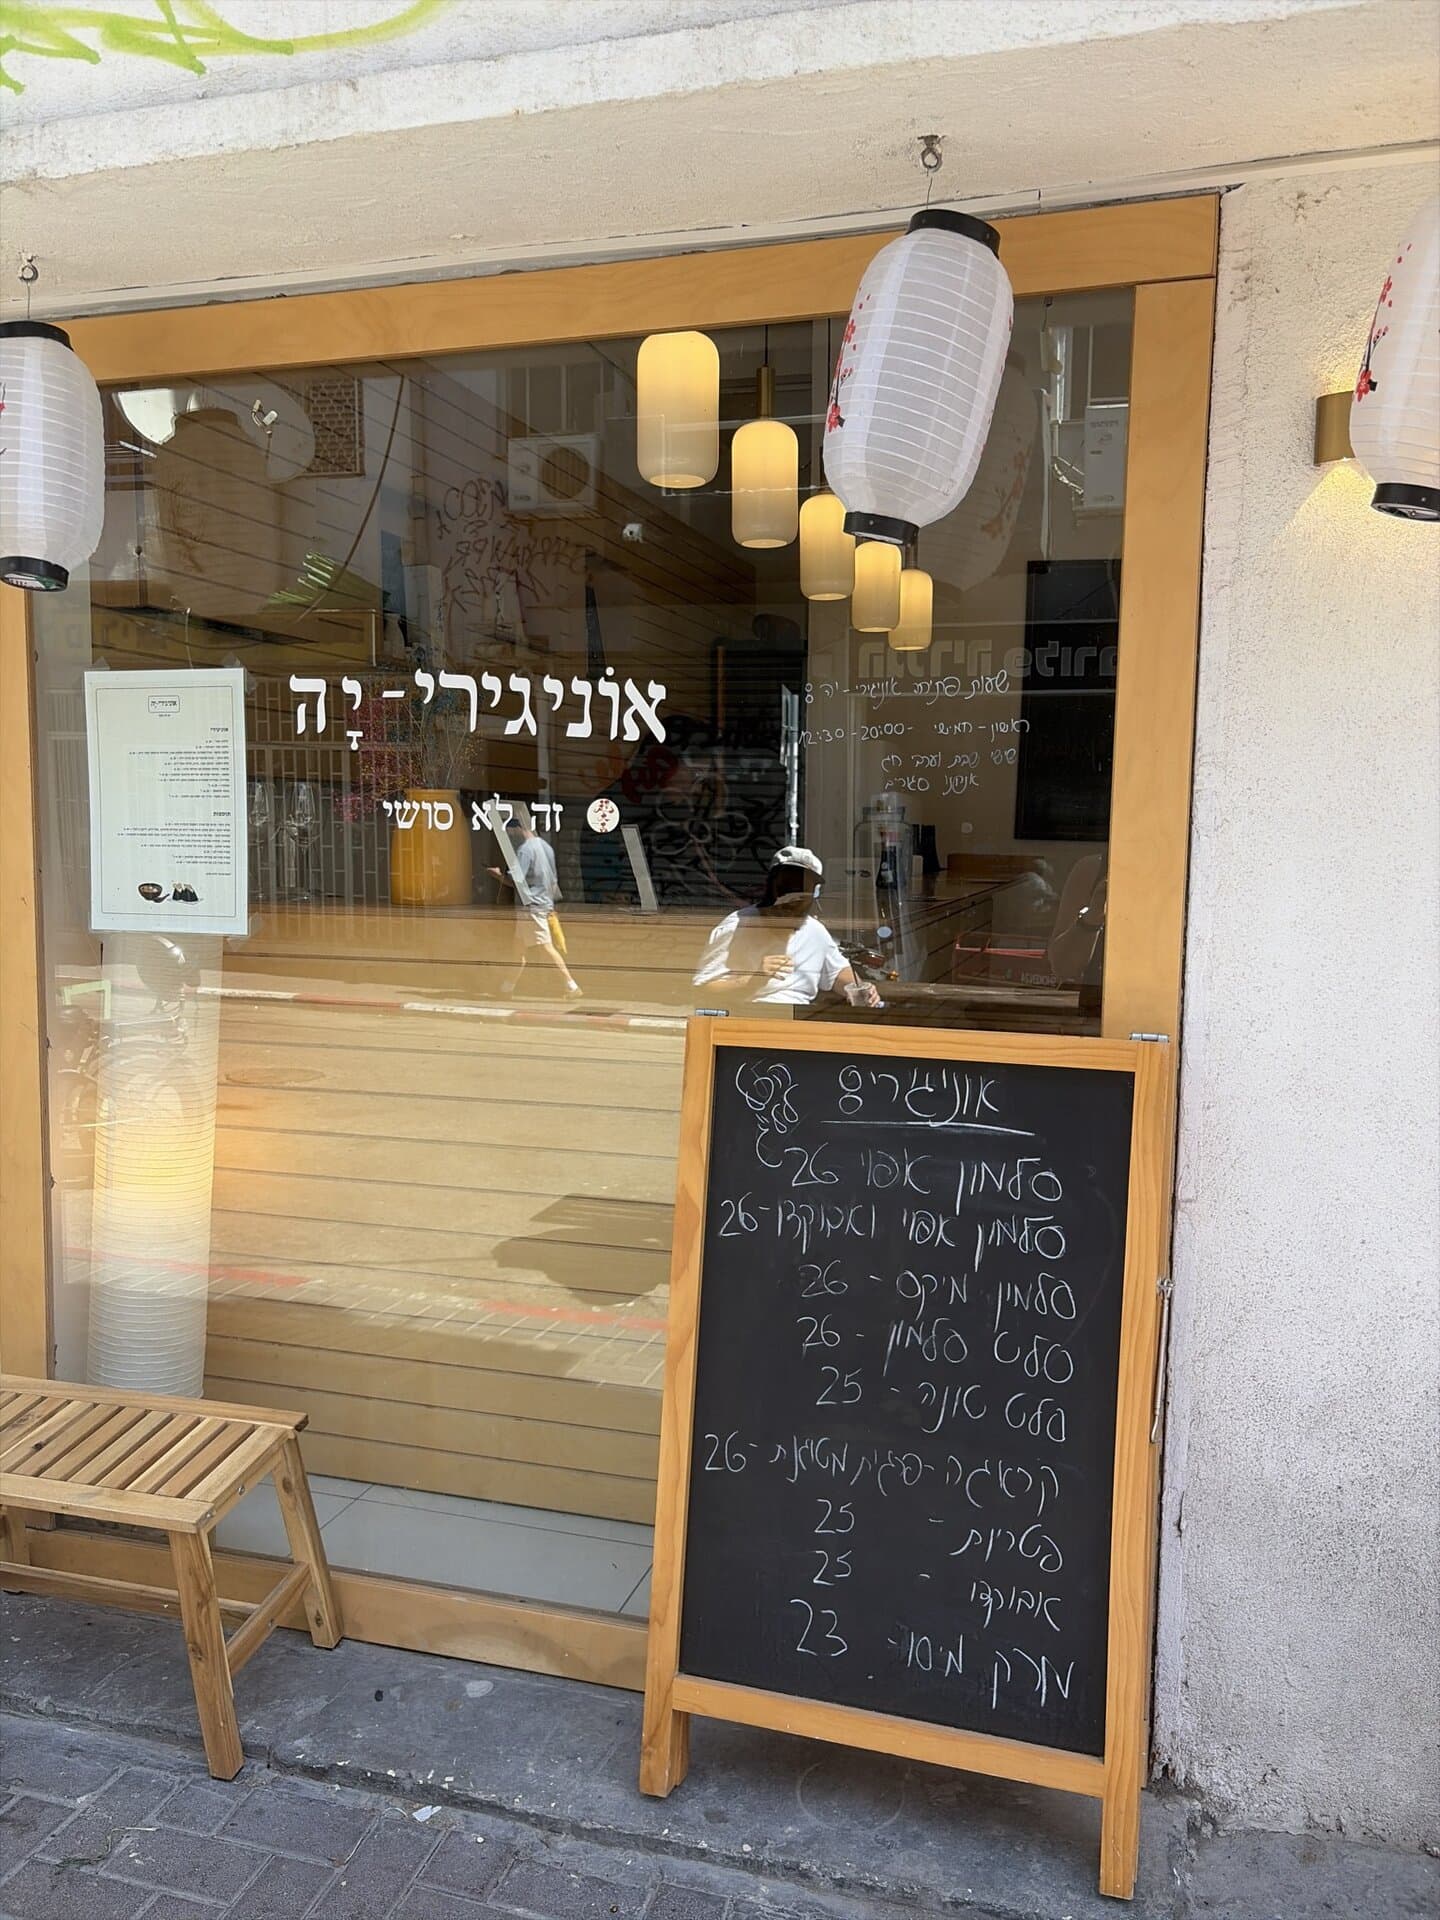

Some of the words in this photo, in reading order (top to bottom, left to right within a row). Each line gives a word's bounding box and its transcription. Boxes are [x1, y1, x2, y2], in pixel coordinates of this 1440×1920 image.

[964, 669, 1010, 700] שעות
[382, 799, 454, 830] סושי
[471, 792, 514, 833] לא
[530, 801, 564, 833] זה
[783, 1142, 841, 1187] 26
[954, 1157, 1064, 1217] סלמון
[973, 1214, 1067, 1273] סלמון
[798, 1259, 849, 1299] 26
[895, 1268, 969, 1321] מיקס
[796, 1313, 841, 1353] 26
[882, 1317, 969, 1378] סלמון
[993, 1331, 1075, 1385] סלט
[815, 1364, 863, 1406] 25
[917, 1381, 988, 1434] טונה
[814, 1498, 856, 1535] 25
[812, 1550, 853, 1586] 25
[789, 1598, 849, 1658] 23
[991, 1646, 1076, 1711] מרק
